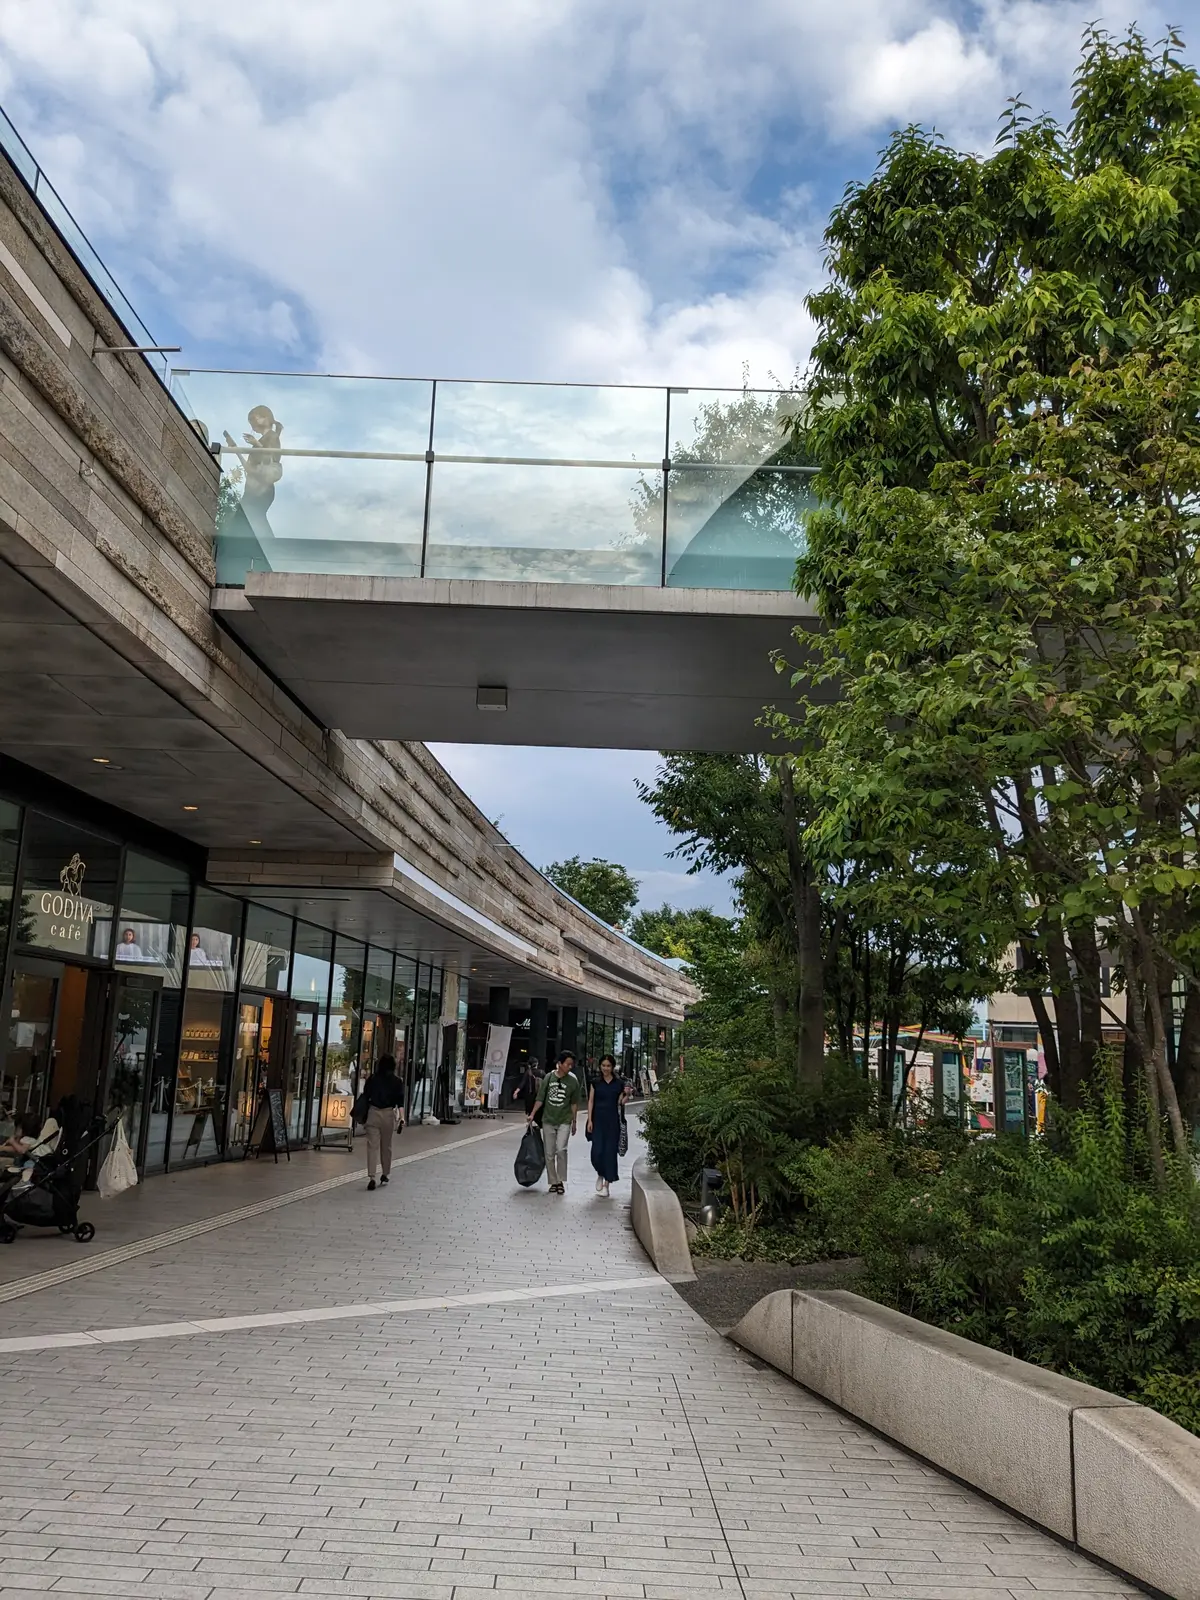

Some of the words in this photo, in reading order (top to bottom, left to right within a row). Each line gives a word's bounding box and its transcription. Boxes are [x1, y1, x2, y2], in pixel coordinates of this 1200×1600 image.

[41, 892, 94, 924] GODIVA
[50, 924, 81, 941] café
[331, 1099, 347, 1118] 85
